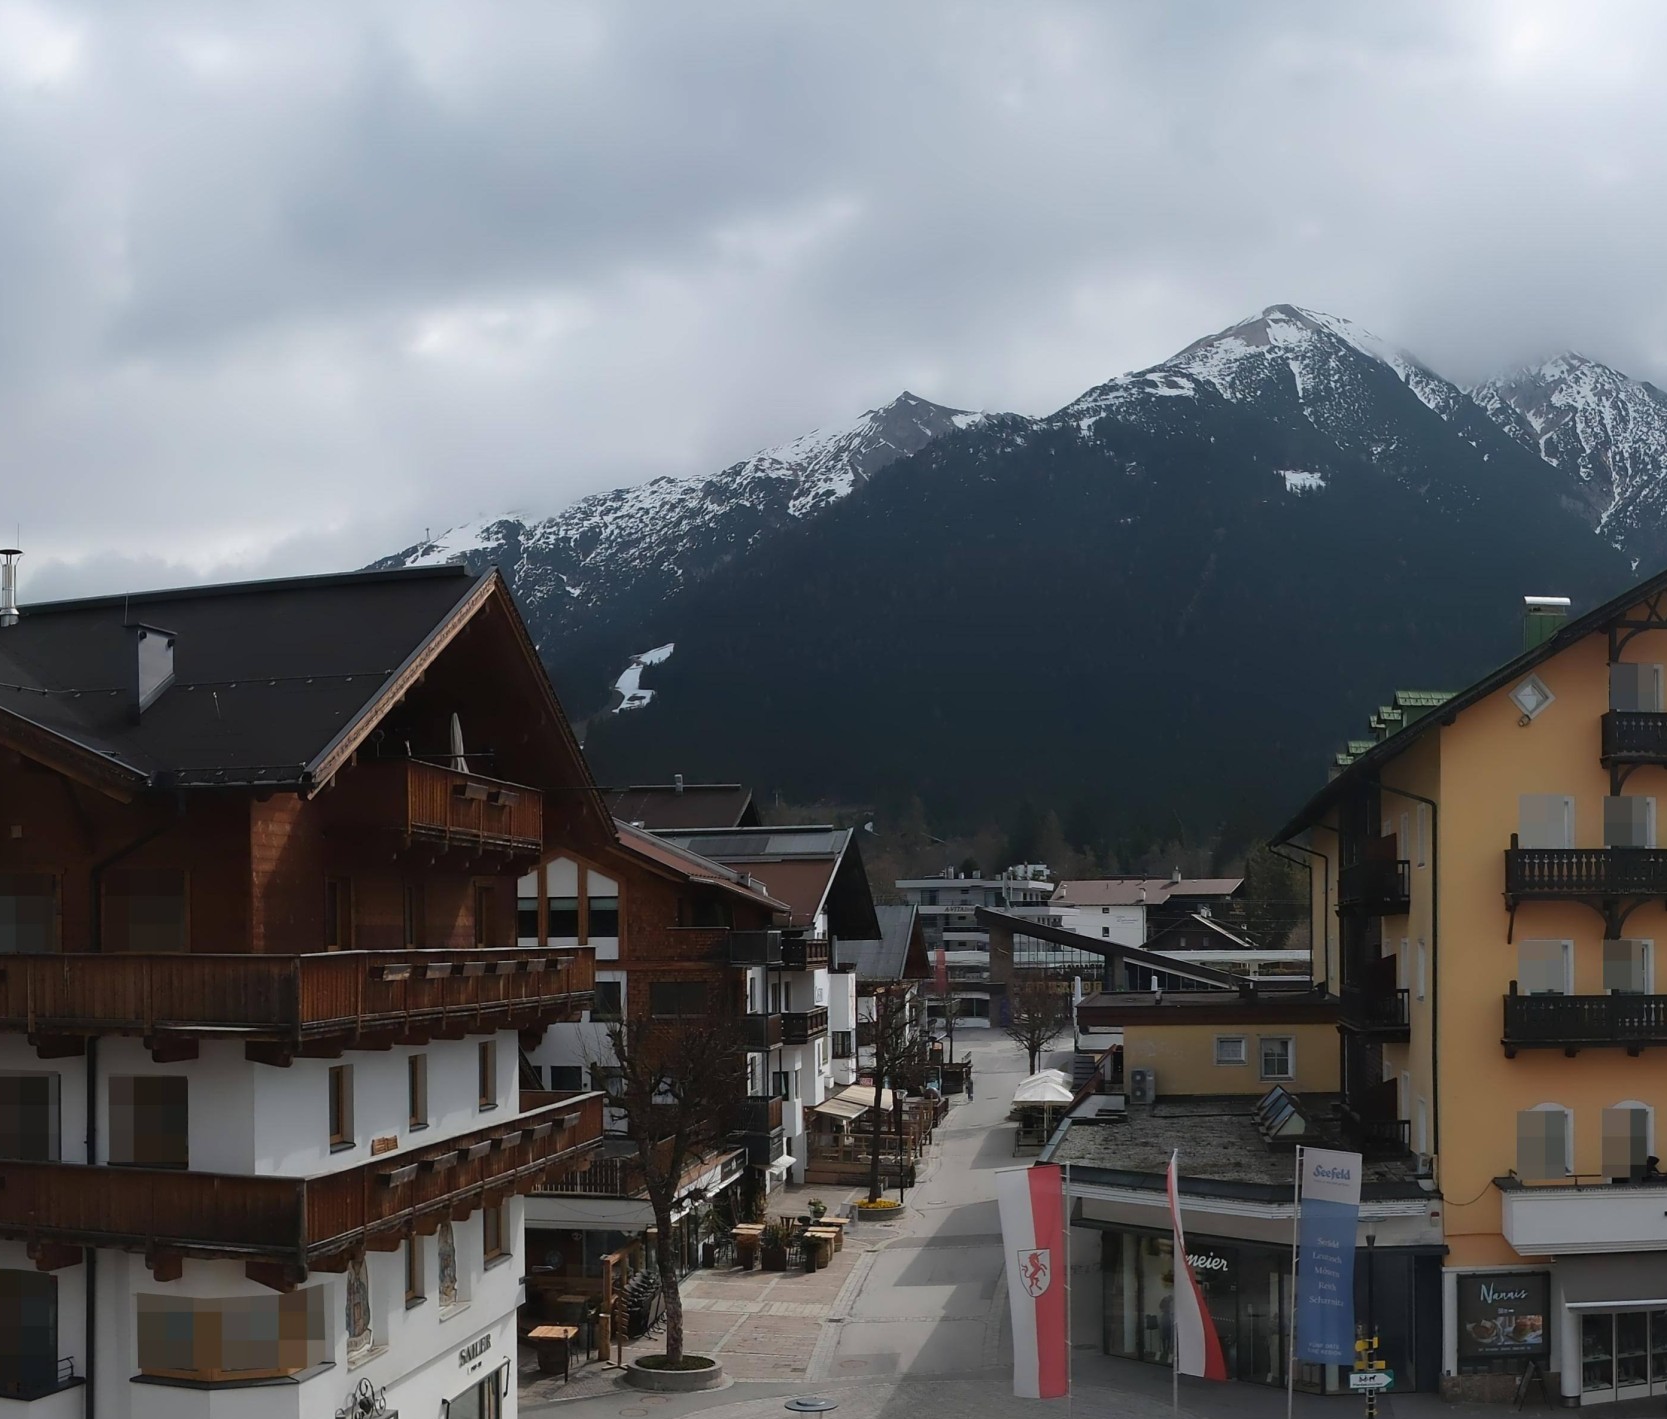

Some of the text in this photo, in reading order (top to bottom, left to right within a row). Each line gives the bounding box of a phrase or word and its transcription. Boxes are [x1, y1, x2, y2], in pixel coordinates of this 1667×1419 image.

[1313, 1164, 1350, 1180] Seefeld
[1480, 1282, 1528, 1304] Nannis
[459, 1333, 491, 1368] SAILER
